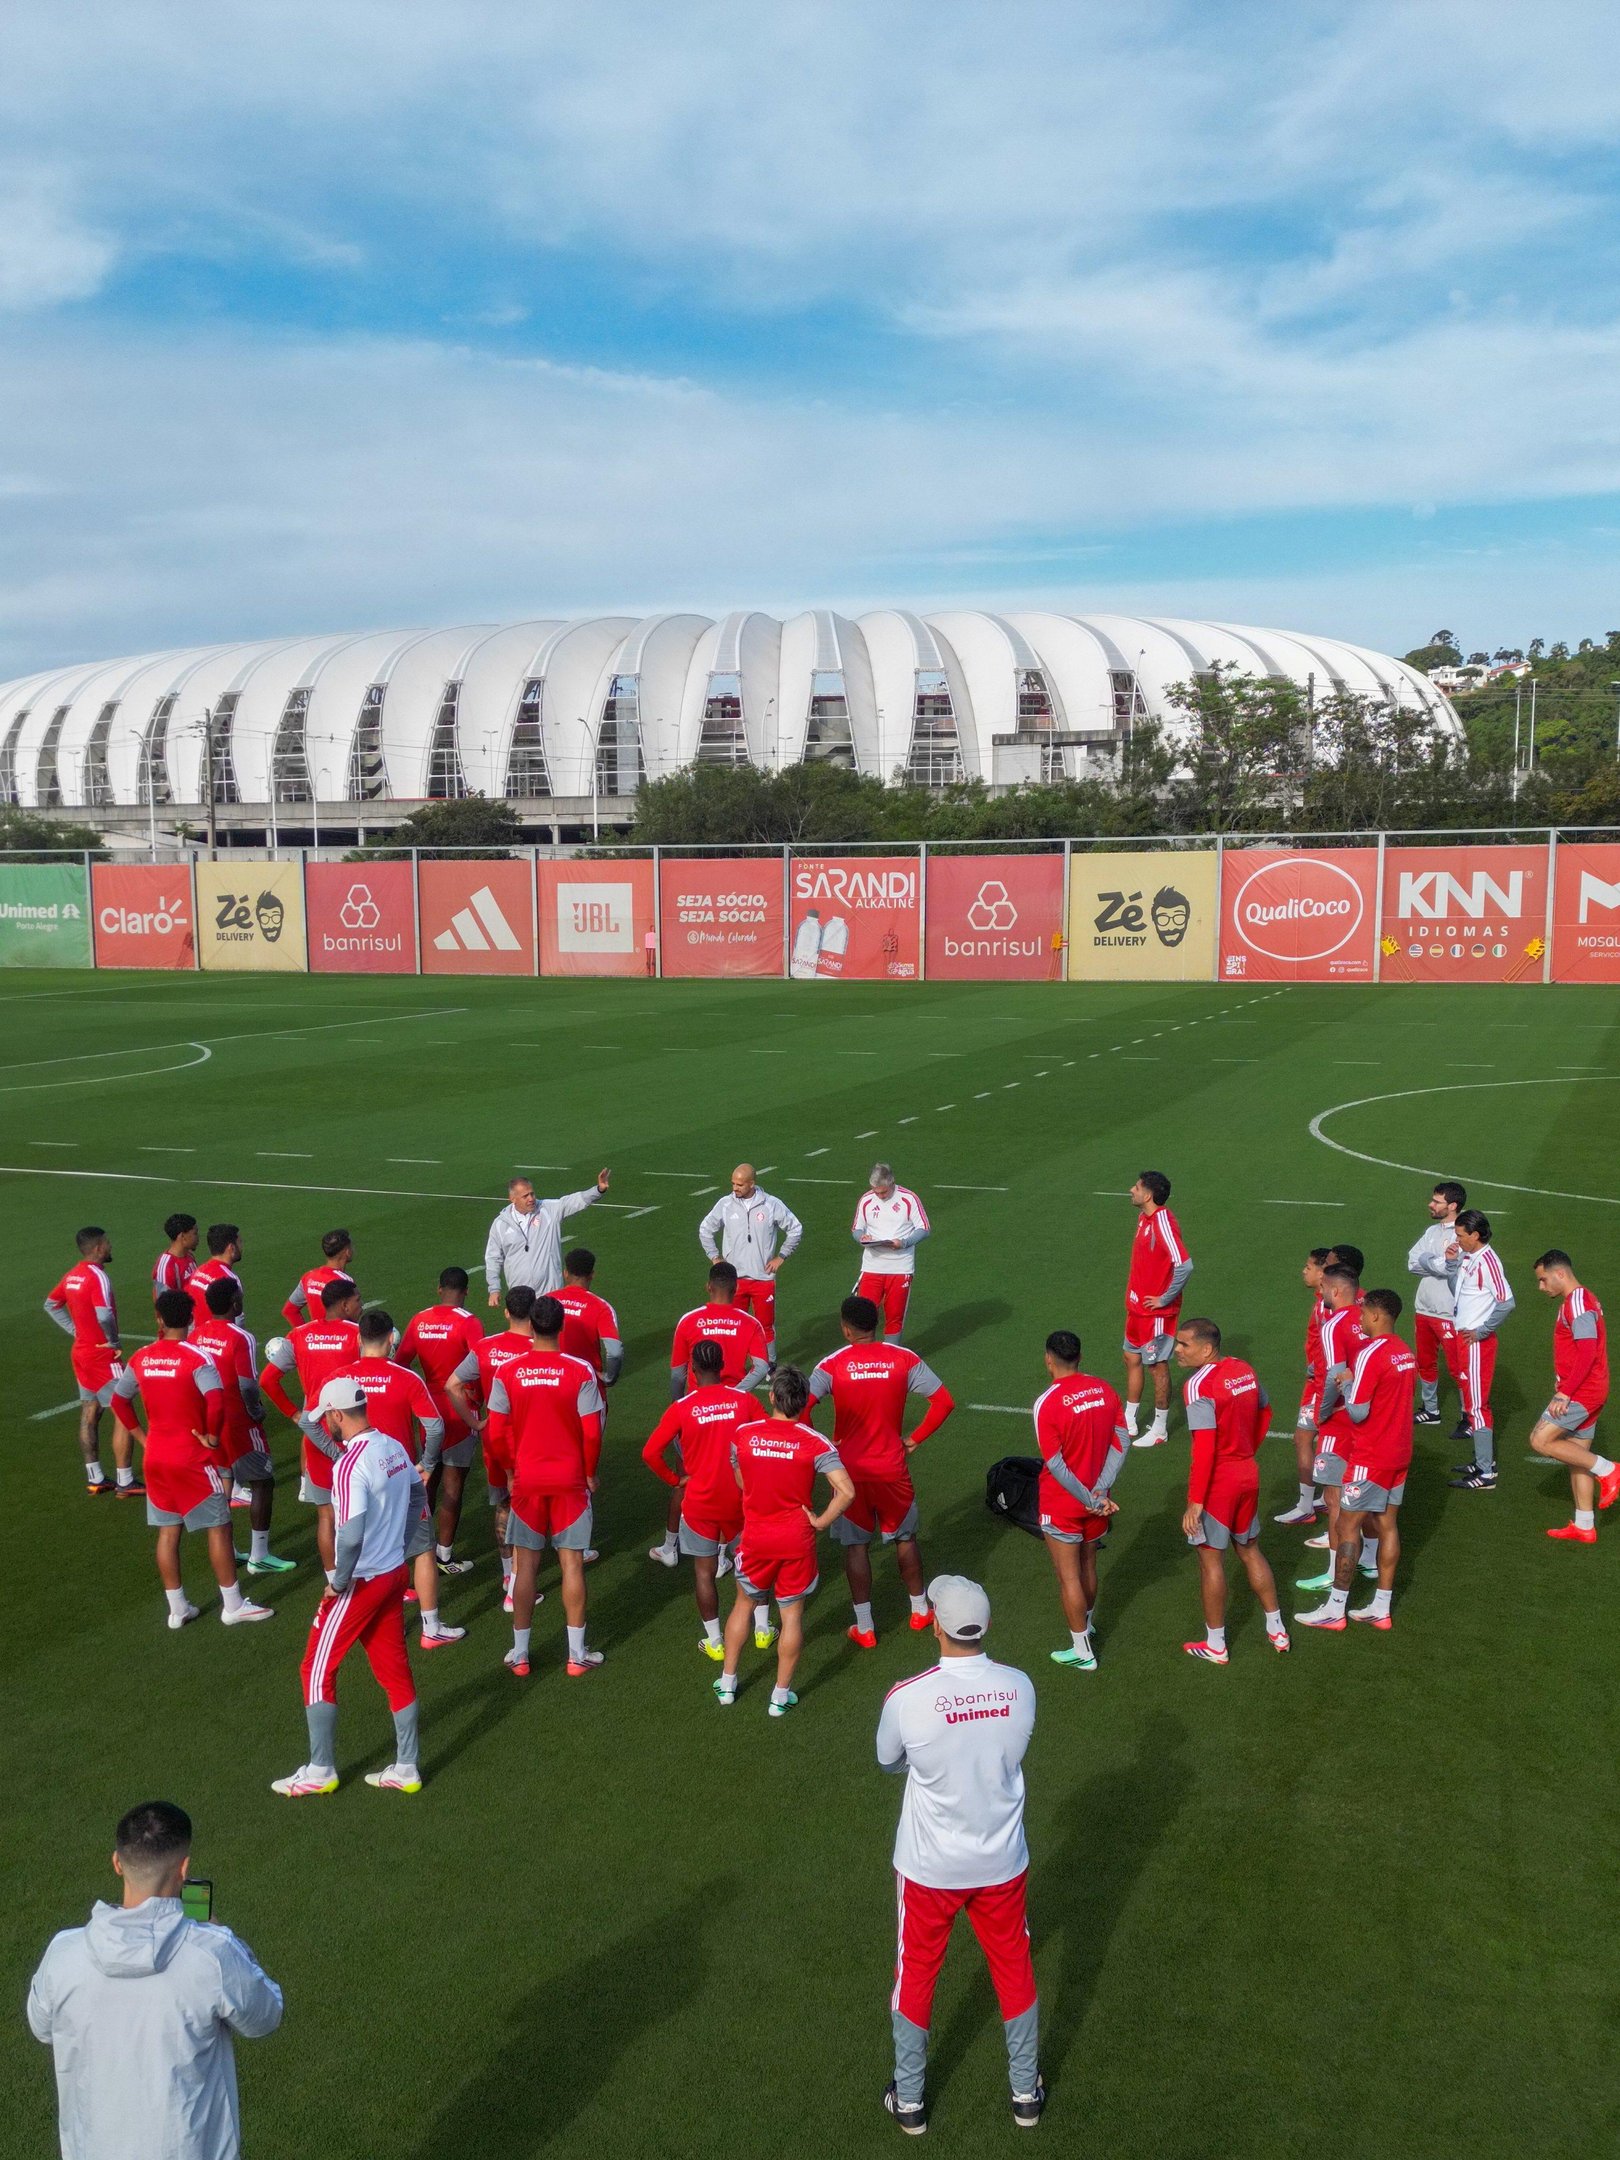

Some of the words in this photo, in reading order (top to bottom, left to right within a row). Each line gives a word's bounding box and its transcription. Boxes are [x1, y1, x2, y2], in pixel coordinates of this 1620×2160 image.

[796, 868, 915, 909] SARANDI
[1398, 871, 1523, 918] KNN
[676, 894, 713, 907] SEJA
[716, 891, 768, 908] SÓCIO,
[855, 898, 915, 909] ALKALINE
[0, 903, 58, 918] Unimed
[215, 894, 254, 929] Zé
[679, 910, 715, 923] SEJA
[718, 907, 766, 923] SÓCIA
[1094, 890, 1148, 933] Zé
[1246, 898, 1350, 926] QualiCoco
[100, 907, 173, 934] Claro
[573, 903, 619, 933] JBL
[16, 921, 35, 930] Porto
[35, 921, 59, 932] Alegre
[1408, 926, 1509, 937] IDIOMAS
[216, 932, 254, 942] DELIVERY
[323, 933, 401, 951] banrisul
[1093, 936, 1147, 947] DELIVERY
[944, 936, 1042, 956] banrisul
[706, 1318, 742, 1326] banrisul
[418, 1331, 448, 1340] Unimed
[702, 1327, 737, 1336] Unimed
[307, 1342, 343, 1350] Unimed
[149, 1357, 181, 1366] banrisul
[857, 1361, 895, 1370] banrisul
[143, 1368, 177, 1378] Unimed
[526, 1367, 564, 1376] banrisul
[850, 1370, 889, 1380] Unimed
[353, 1375, 392, 1384] banrisul
[521, 1377, 560, 1387] Unimed
[361, 1384, 387, 1393] imed
[702, 1401, 738, 1414] banrisul
[1072, 1397, 1105, 1414] Unimed
[697, 1411, 735, 1424] Unimed
[760, 1437, 800, 1450] banrisul
[752, 1447, 793, 1460] Unimed
[954, 1689, 1018, 1706] banrisul
[945, 1704, 1010, 1725] Unimed
